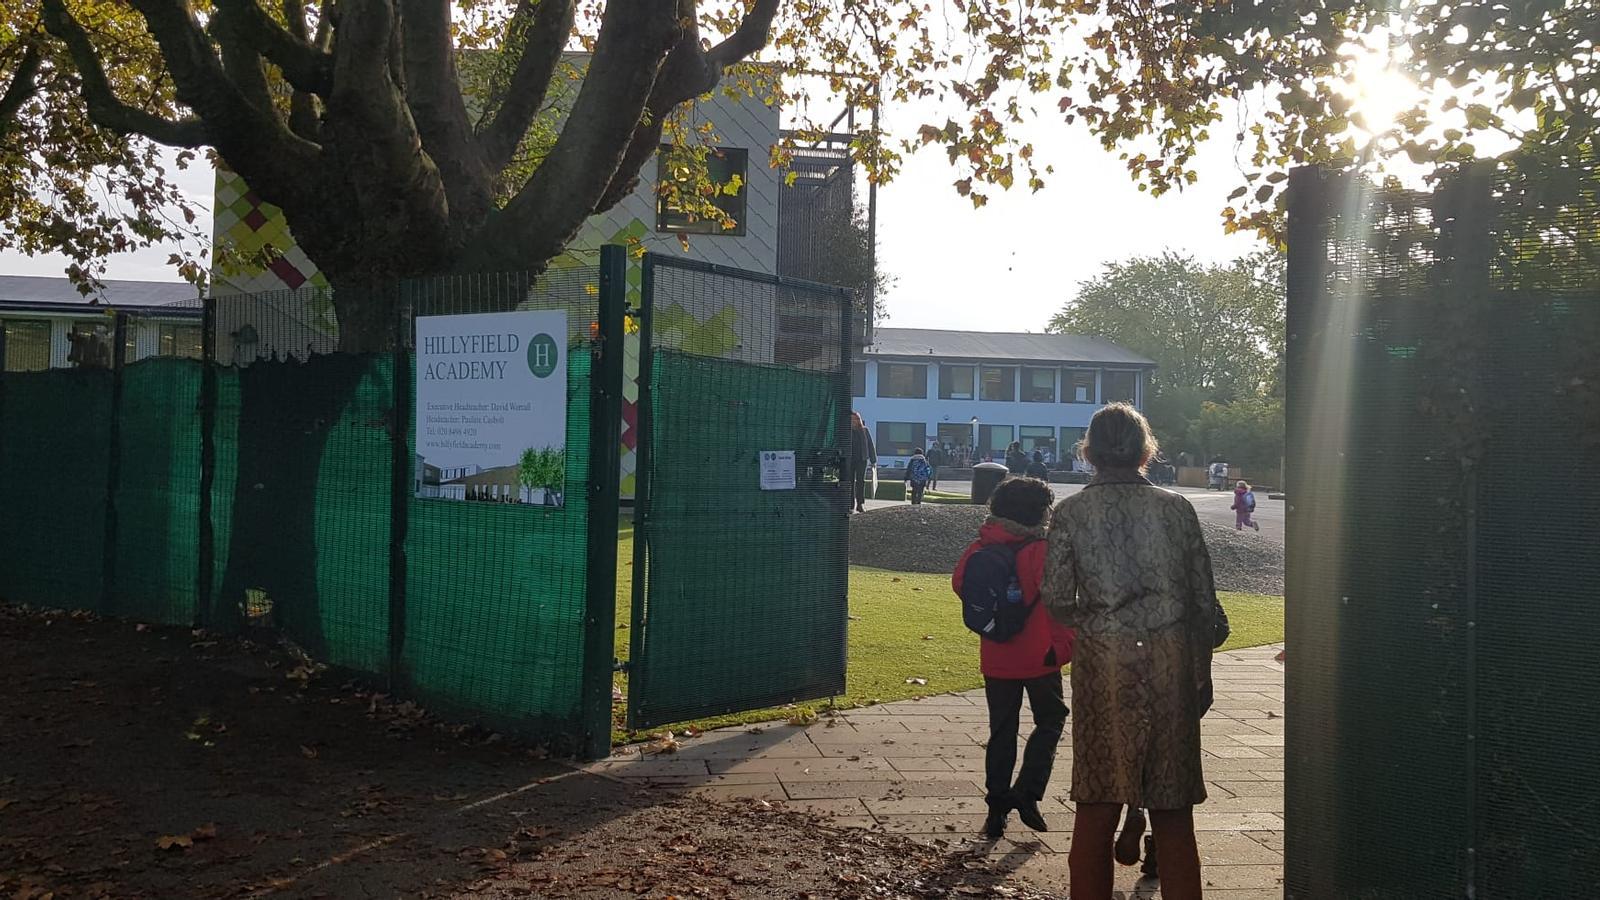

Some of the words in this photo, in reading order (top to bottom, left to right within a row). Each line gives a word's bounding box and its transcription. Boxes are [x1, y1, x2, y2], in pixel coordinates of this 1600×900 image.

[424, 334, 519, 354] HILLYFIELD
[534, 343, 550, 367] H
[424, 361, 507, 380] ACADEMY
[491, 402, 508, 411] David
